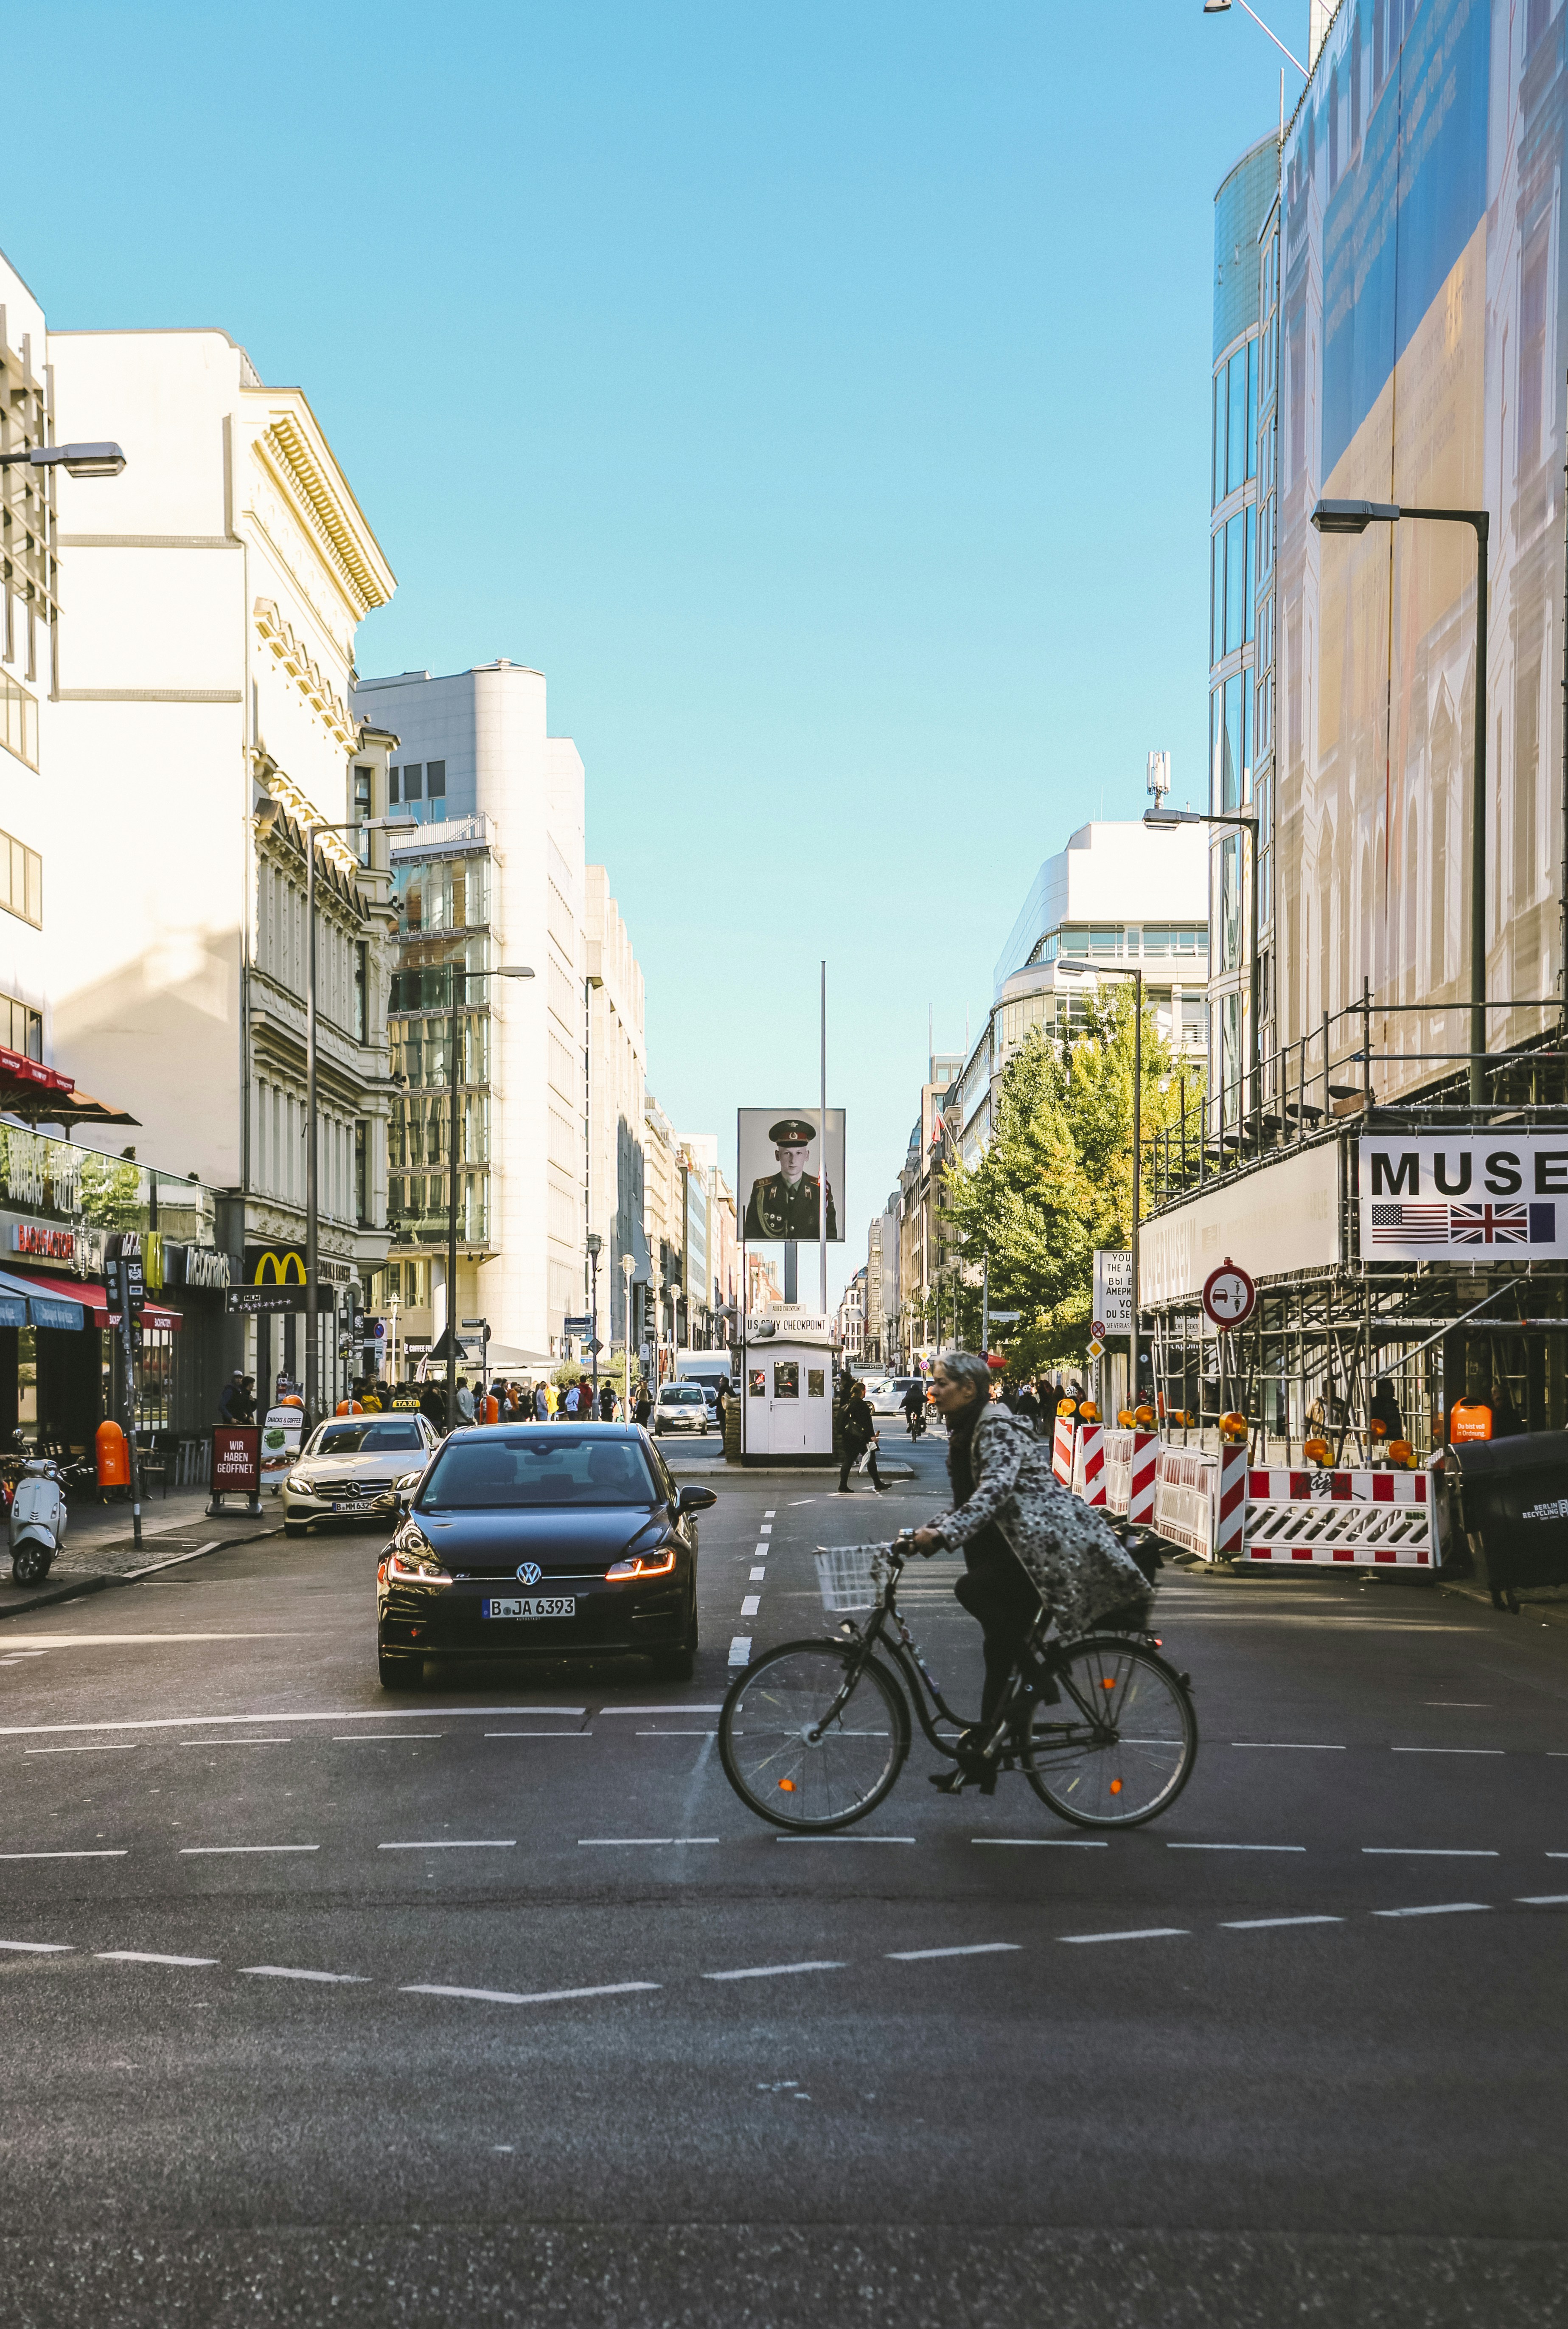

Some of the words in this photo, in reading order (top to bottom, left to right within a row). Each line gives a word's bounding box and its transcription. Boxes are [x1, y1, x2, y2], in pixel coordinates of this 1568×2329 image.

[1112, 1254, 1130, 1262] YOU
[1108, 1264, 1121, 1272] THE
[1119, 1300, 1132, 1308] VO
[1106, 1310, 1116, 1318] DU
[784, 1320, 825, 1330] CHECKPOINT
[230, 1441, 244, 1450] WIR
[224, 1452, 248, 1462] HABEN
[217, 1463, 254, 1474] GEÖFFNET.
[1534, 1503, 1557, 1511] BERLIN
[1522, 1509, 1559, 1518] RECYCLING
[491, 1601, 501, 1616] B
[512, 1600, 532, 1615] JA
[536, 1599, 573, 1615] 6393
